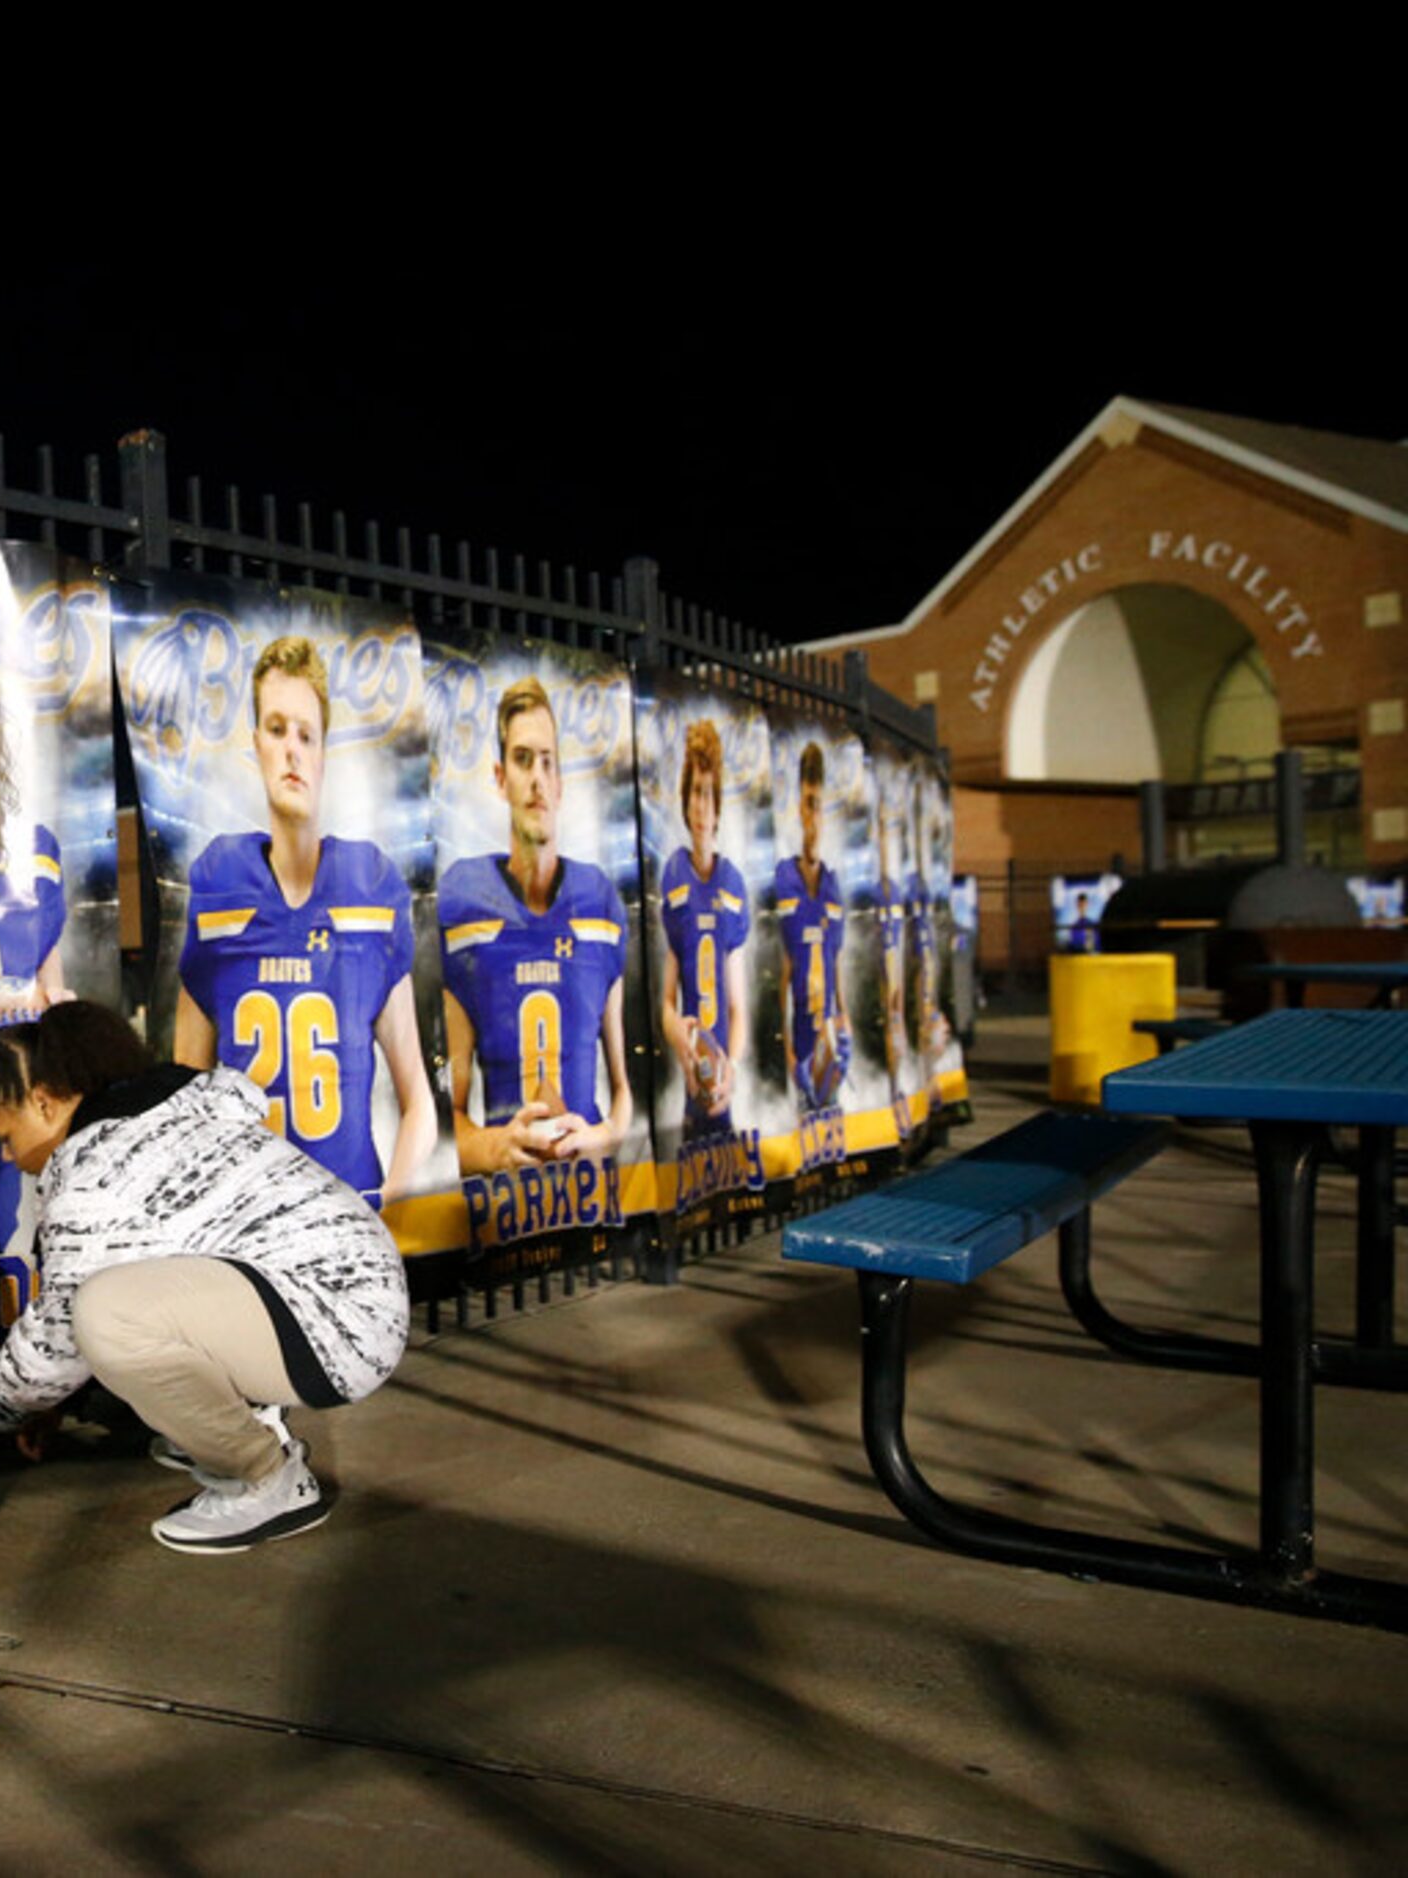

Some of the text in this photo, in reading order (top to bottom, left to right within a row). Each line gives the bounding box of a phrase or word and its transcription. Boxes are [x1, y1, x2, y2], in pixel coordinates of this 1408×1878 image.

[968, 530, 1325, 714] ATHLETIC FACILITY
[233, 989, 342, 1141] 26
